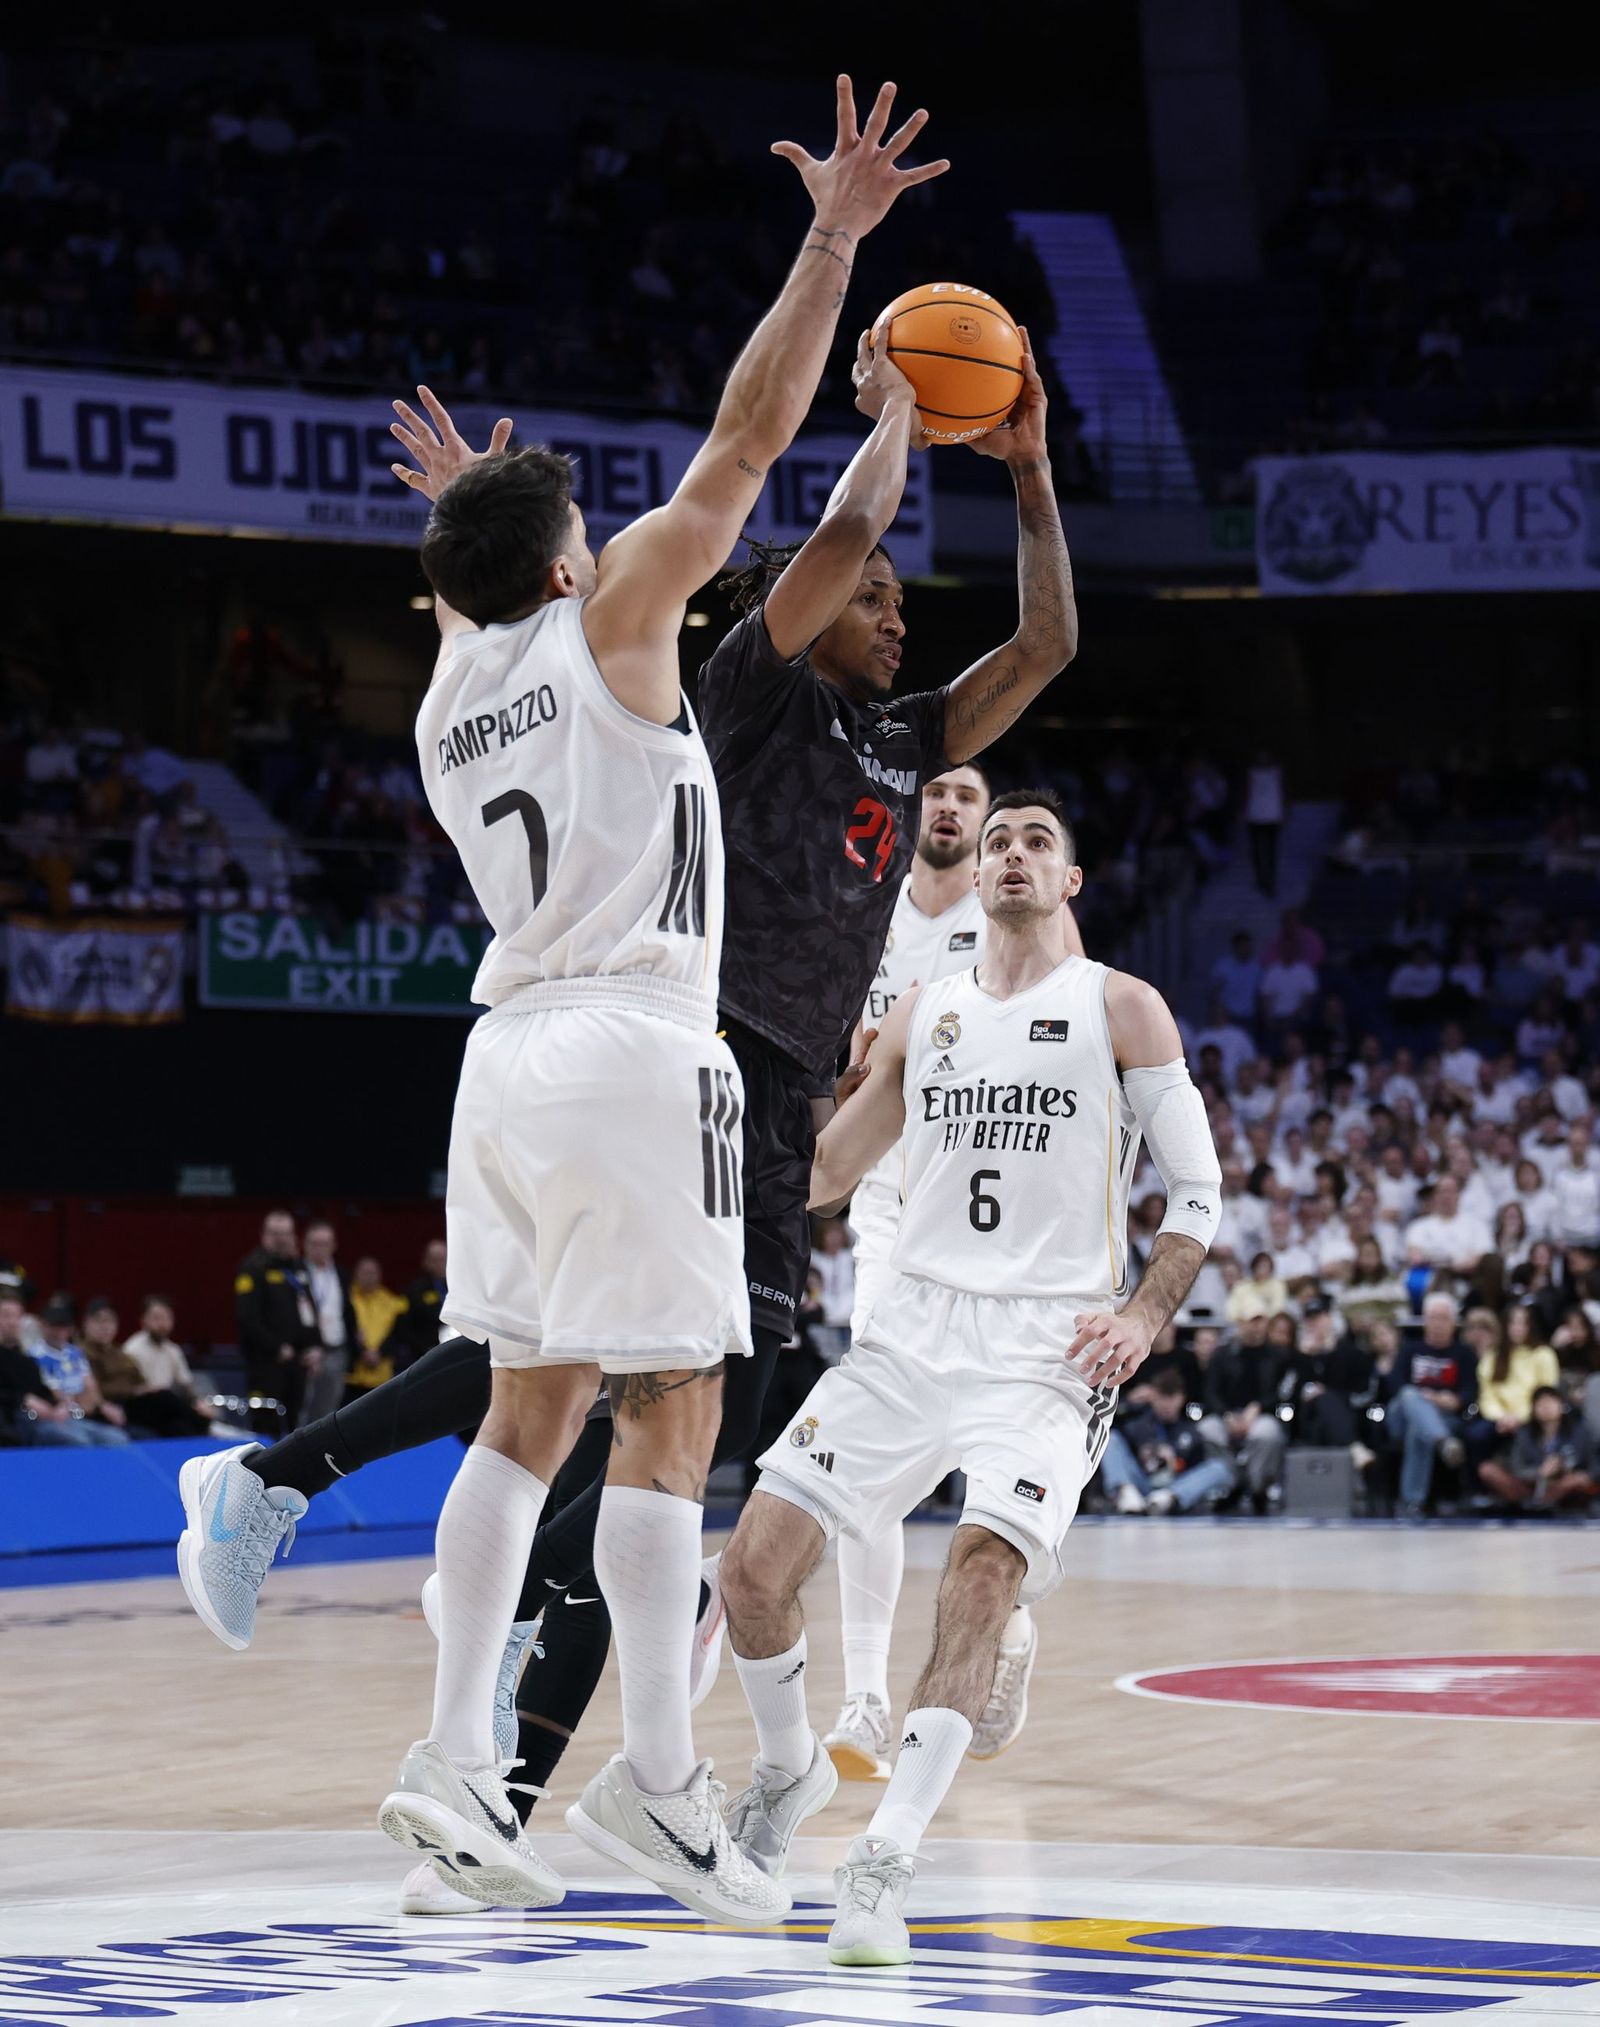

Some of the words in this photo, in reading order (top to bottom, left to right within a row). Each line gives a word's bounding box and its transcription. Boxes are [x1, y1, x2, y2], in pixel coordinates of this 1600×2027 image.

[22, 395, 176, 479] LOS
[226, 413, 412, 497] OJOS
[1366, 479, 1581, 543] REYES
[438, 683, 558, 776] CAMPAZZO
[481, 788, 549, 912] 7
[843, 796, 897, 884] 24
[217, 911, 472, 967] SALIDA
[287, 964, 402, 1005] EXIT
[1032, 1025, 1049, 1034] liga
[920, 1077, 1078, 1122] Emirates
[972, 1120, 1051, 1152] BETTER
[968, 1168, 1002, 1233] 6
[1016, 1485, 1038, 1499] acb
